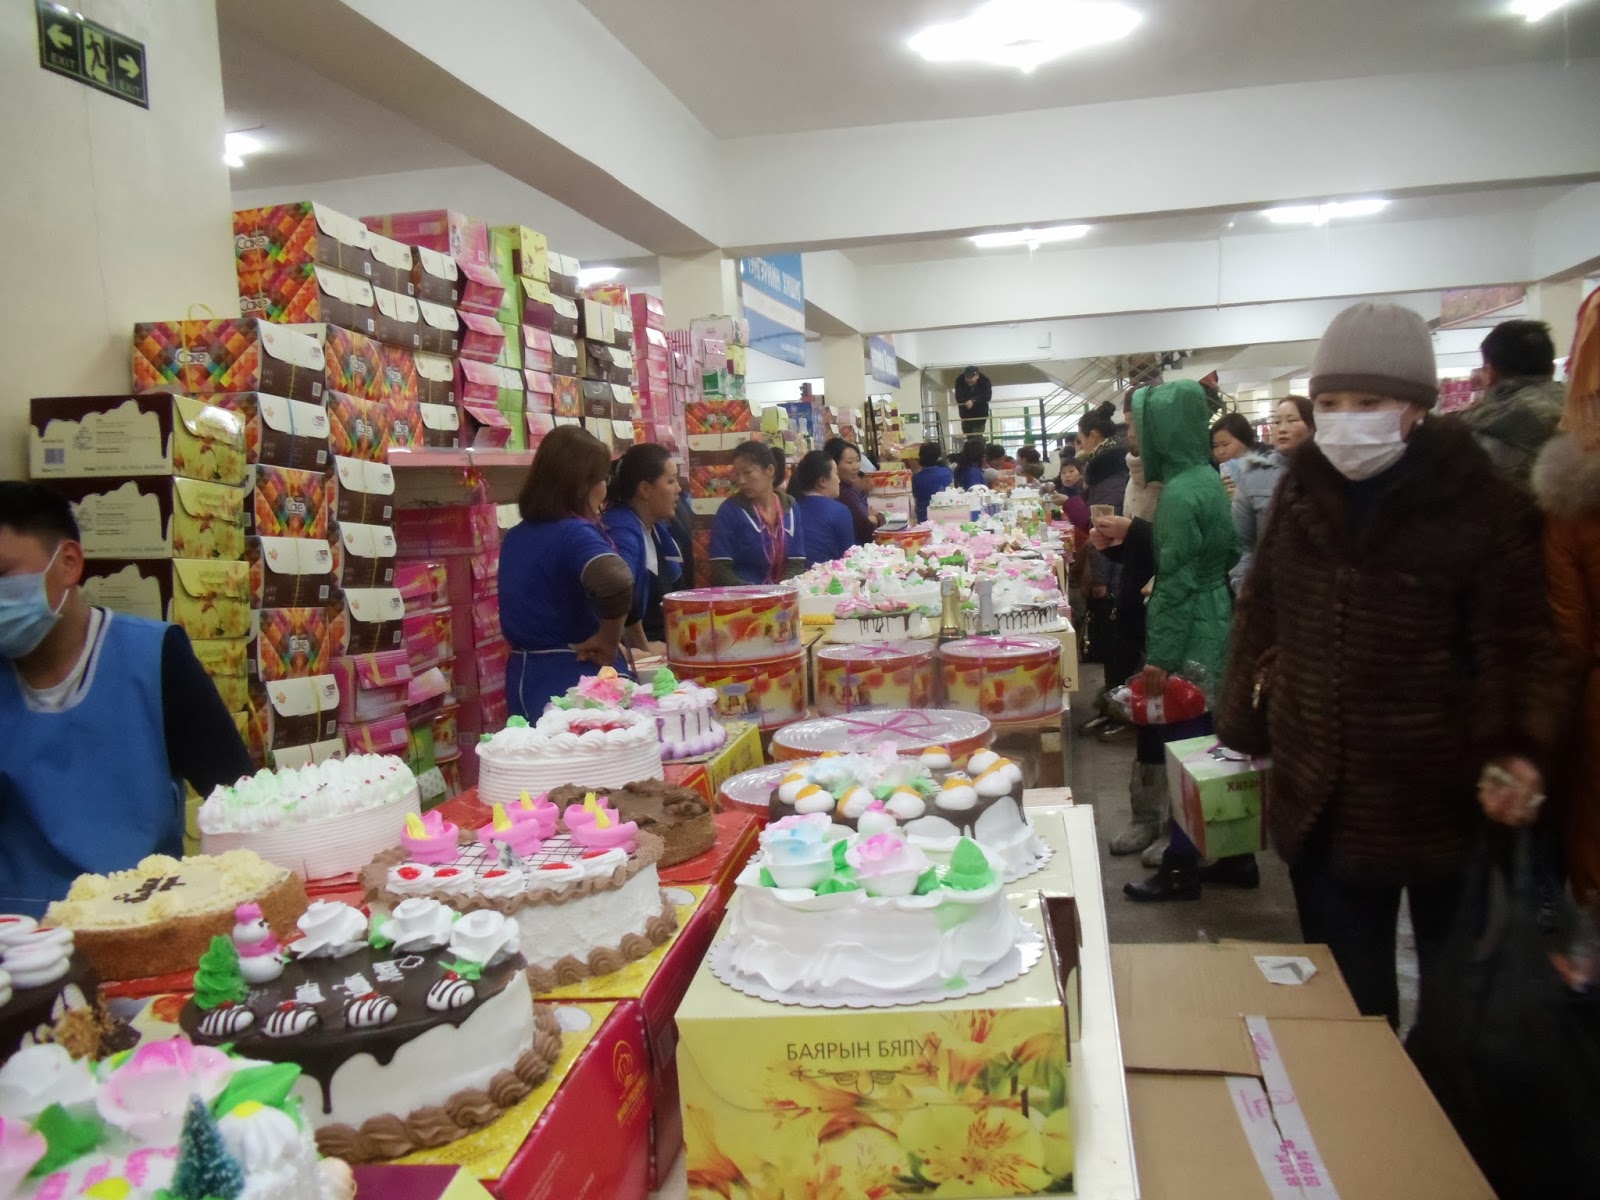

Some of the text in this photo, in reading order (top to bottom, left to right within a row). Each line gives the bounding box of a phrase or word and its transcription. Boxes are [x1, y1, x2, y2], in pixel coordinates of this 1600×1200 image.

[51, 52, 75, 70] EXIT
[119, 79, 140, 96] EXIT
[236, 237, 265, 250] Cake
[177, 349, 206, 364] Cake
[787, 1040, 871, 1061] БАЯРЫН
